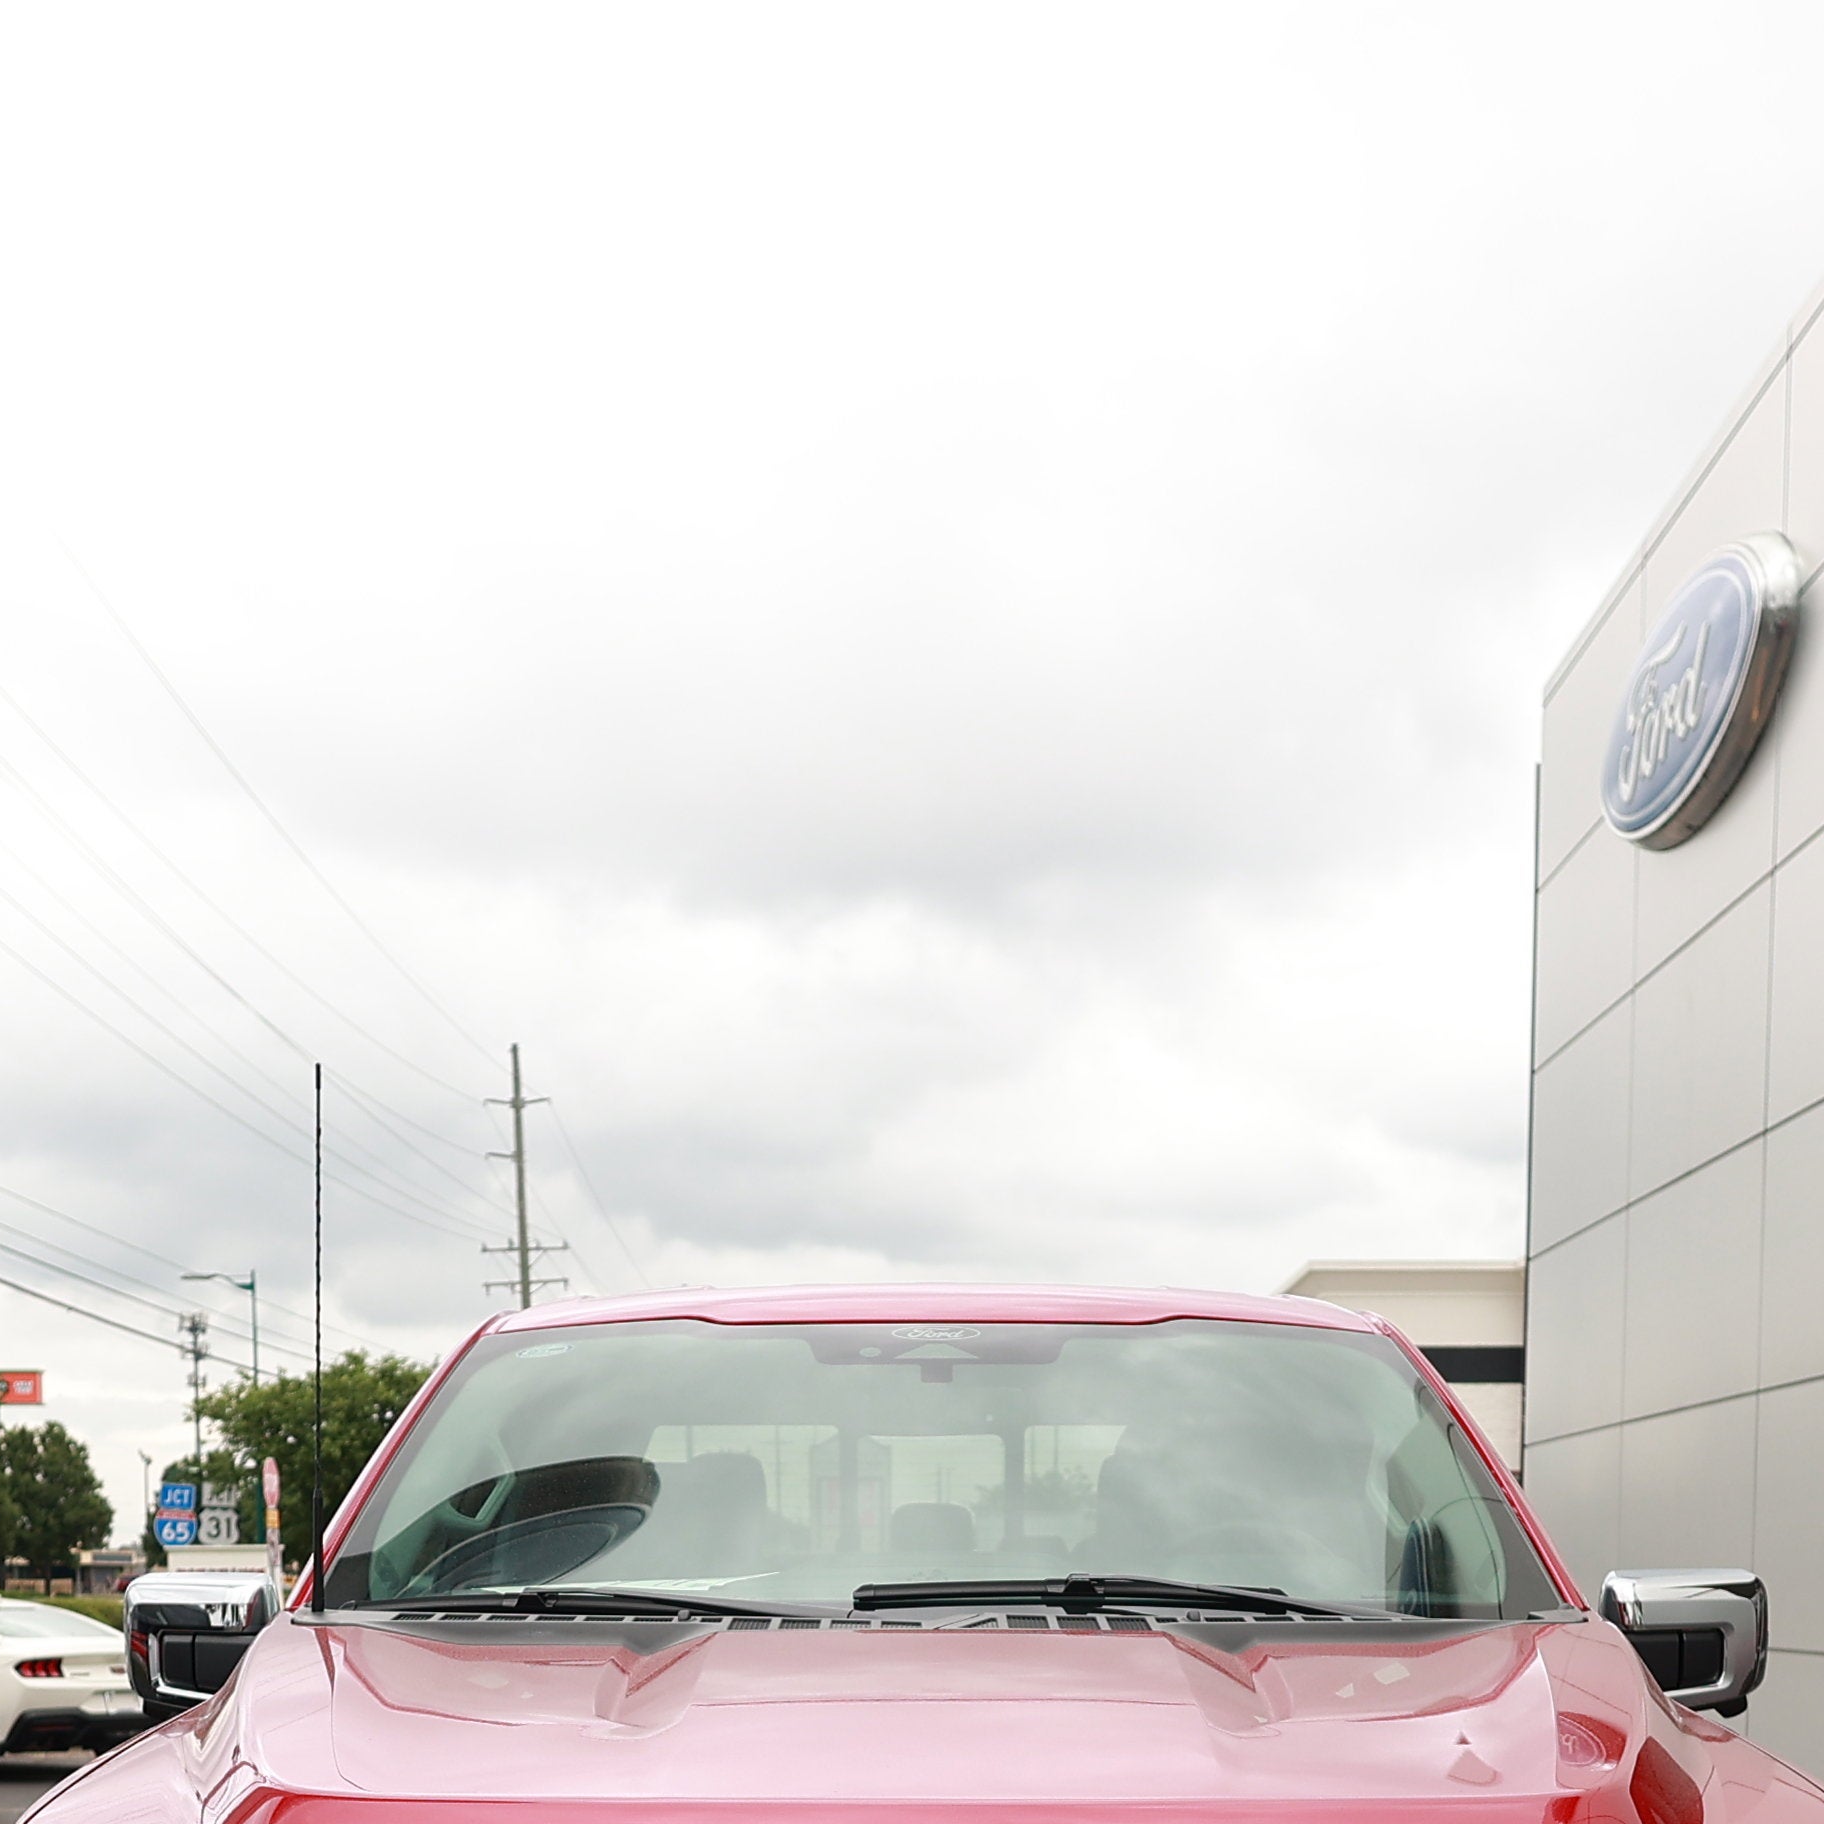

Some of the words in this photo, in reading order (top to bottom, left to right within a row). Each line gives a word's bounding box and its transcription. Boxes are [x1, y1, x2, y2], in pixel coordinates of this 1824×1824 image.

[1619, 620, 1710, 802] Ford
[907, 1327, 965, 1338] Ford
[164, 1489, 190, 1504] JCT
[162, 1521, 190, 1542] 65
[207, 1516, 232, 1539] 31
